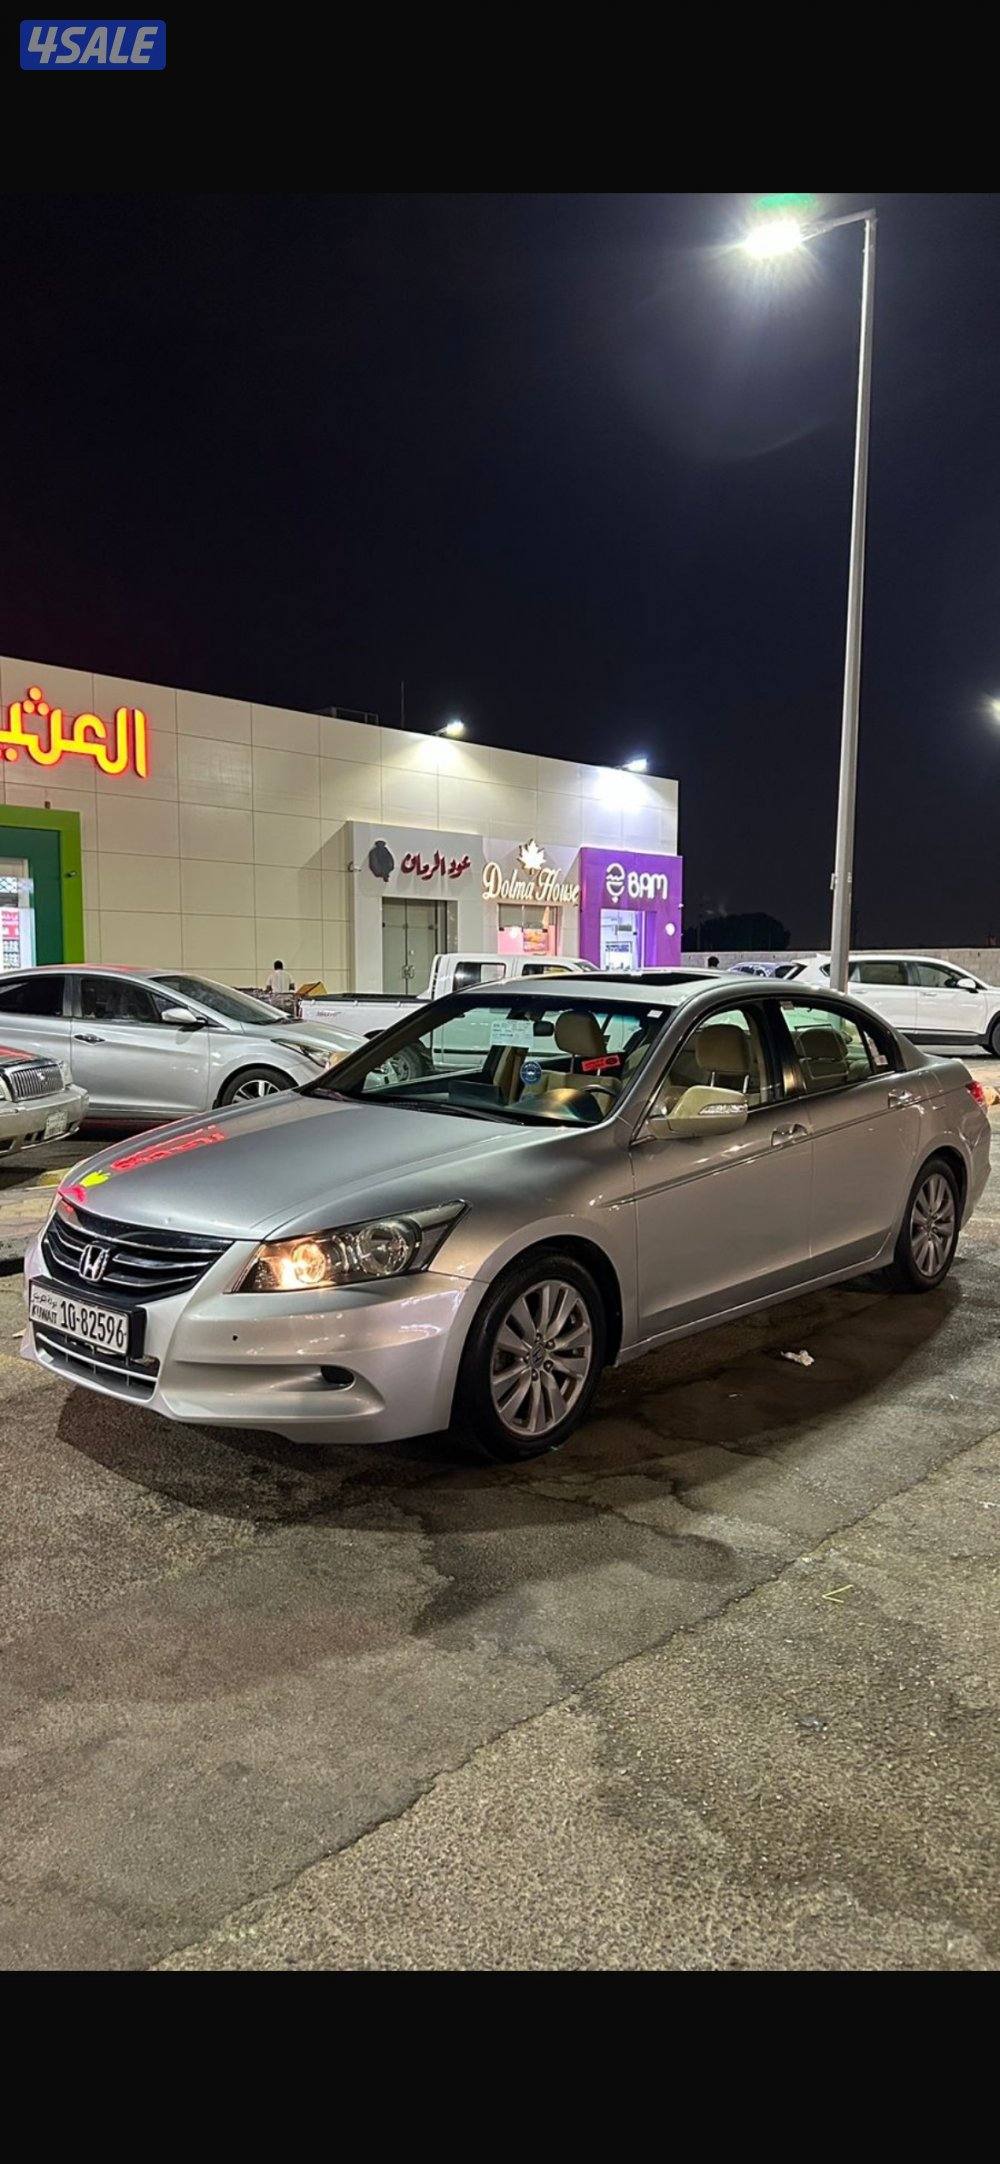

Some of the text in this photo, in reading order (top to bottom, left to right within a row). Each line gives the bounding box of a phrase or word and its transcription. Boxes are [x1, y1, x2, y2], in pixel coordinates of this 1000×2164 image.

[0, 686, 147, 778] العثي
[401, 849, 471, 880] عود الرمان
[482, 861, 581, 904] Dolma House
[628, 872, 668, 900] BAM
[32, 1304, 57, 1324] KUWAIT
[60, 1300, 124, 1348] 10-82596
